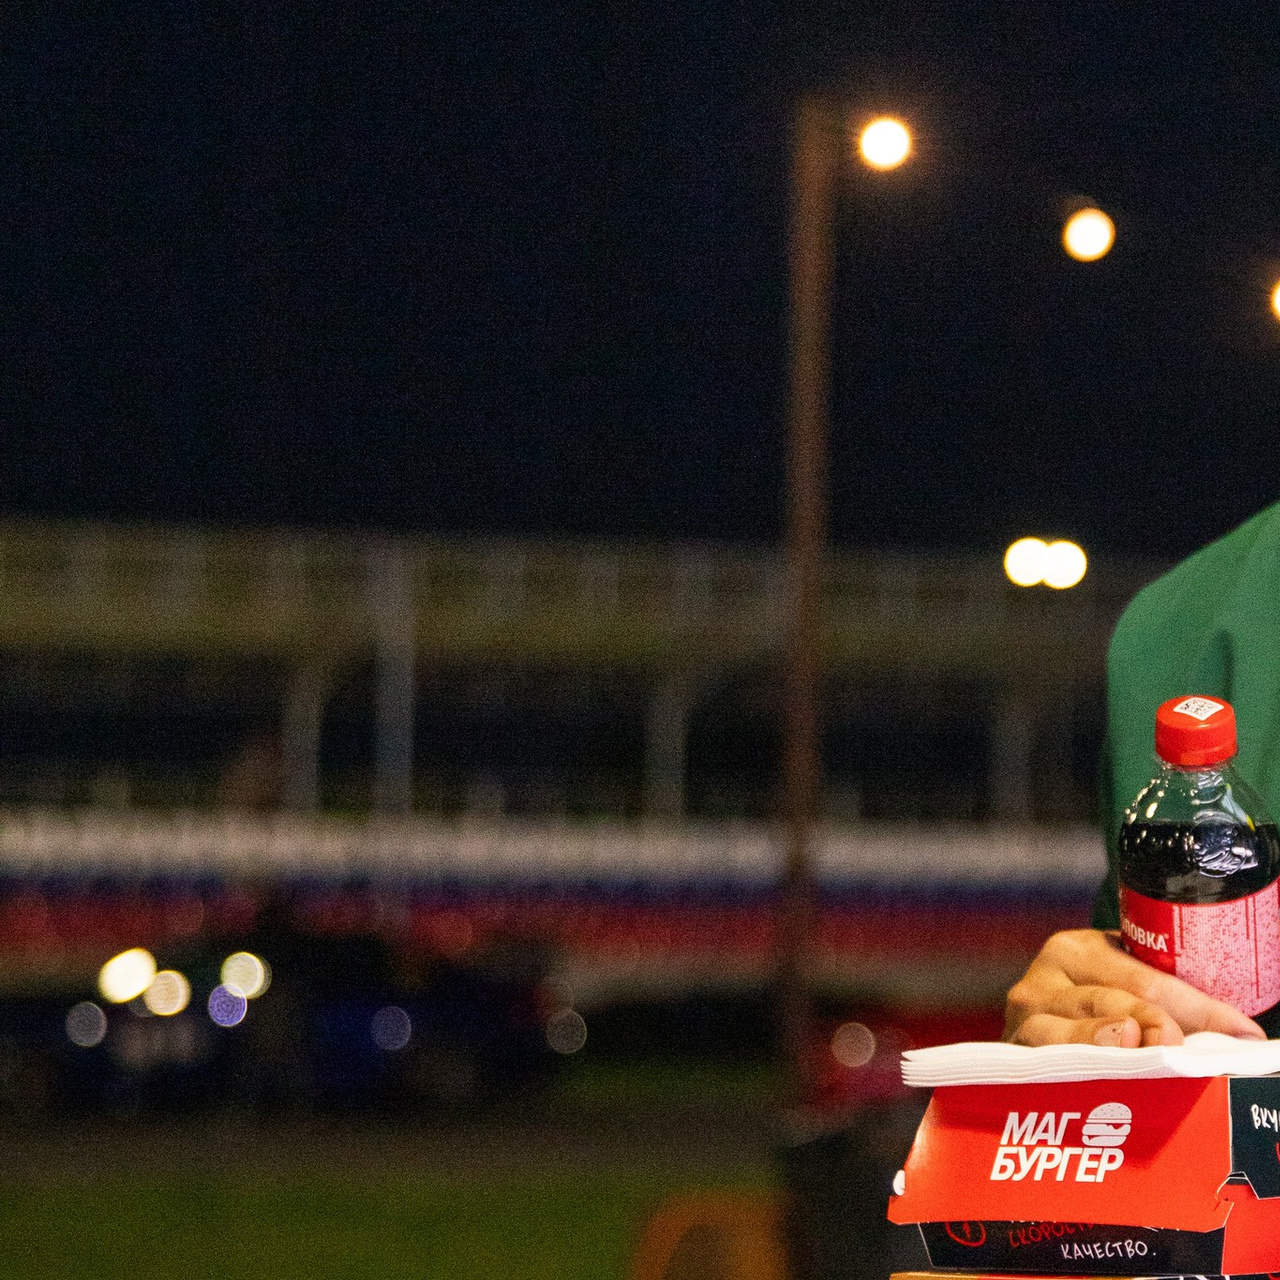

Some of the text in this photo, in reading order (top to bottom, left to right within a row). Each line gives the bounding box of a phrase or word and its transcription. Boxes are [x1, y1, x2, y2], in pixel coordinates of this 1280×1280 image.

[1000, 1112, 1082, 1146] МАГ
[990, 1146, 1125, 1183] БУРГЕР
[1060, 1239, 1157, 1260] КАЧЕСТВО.
